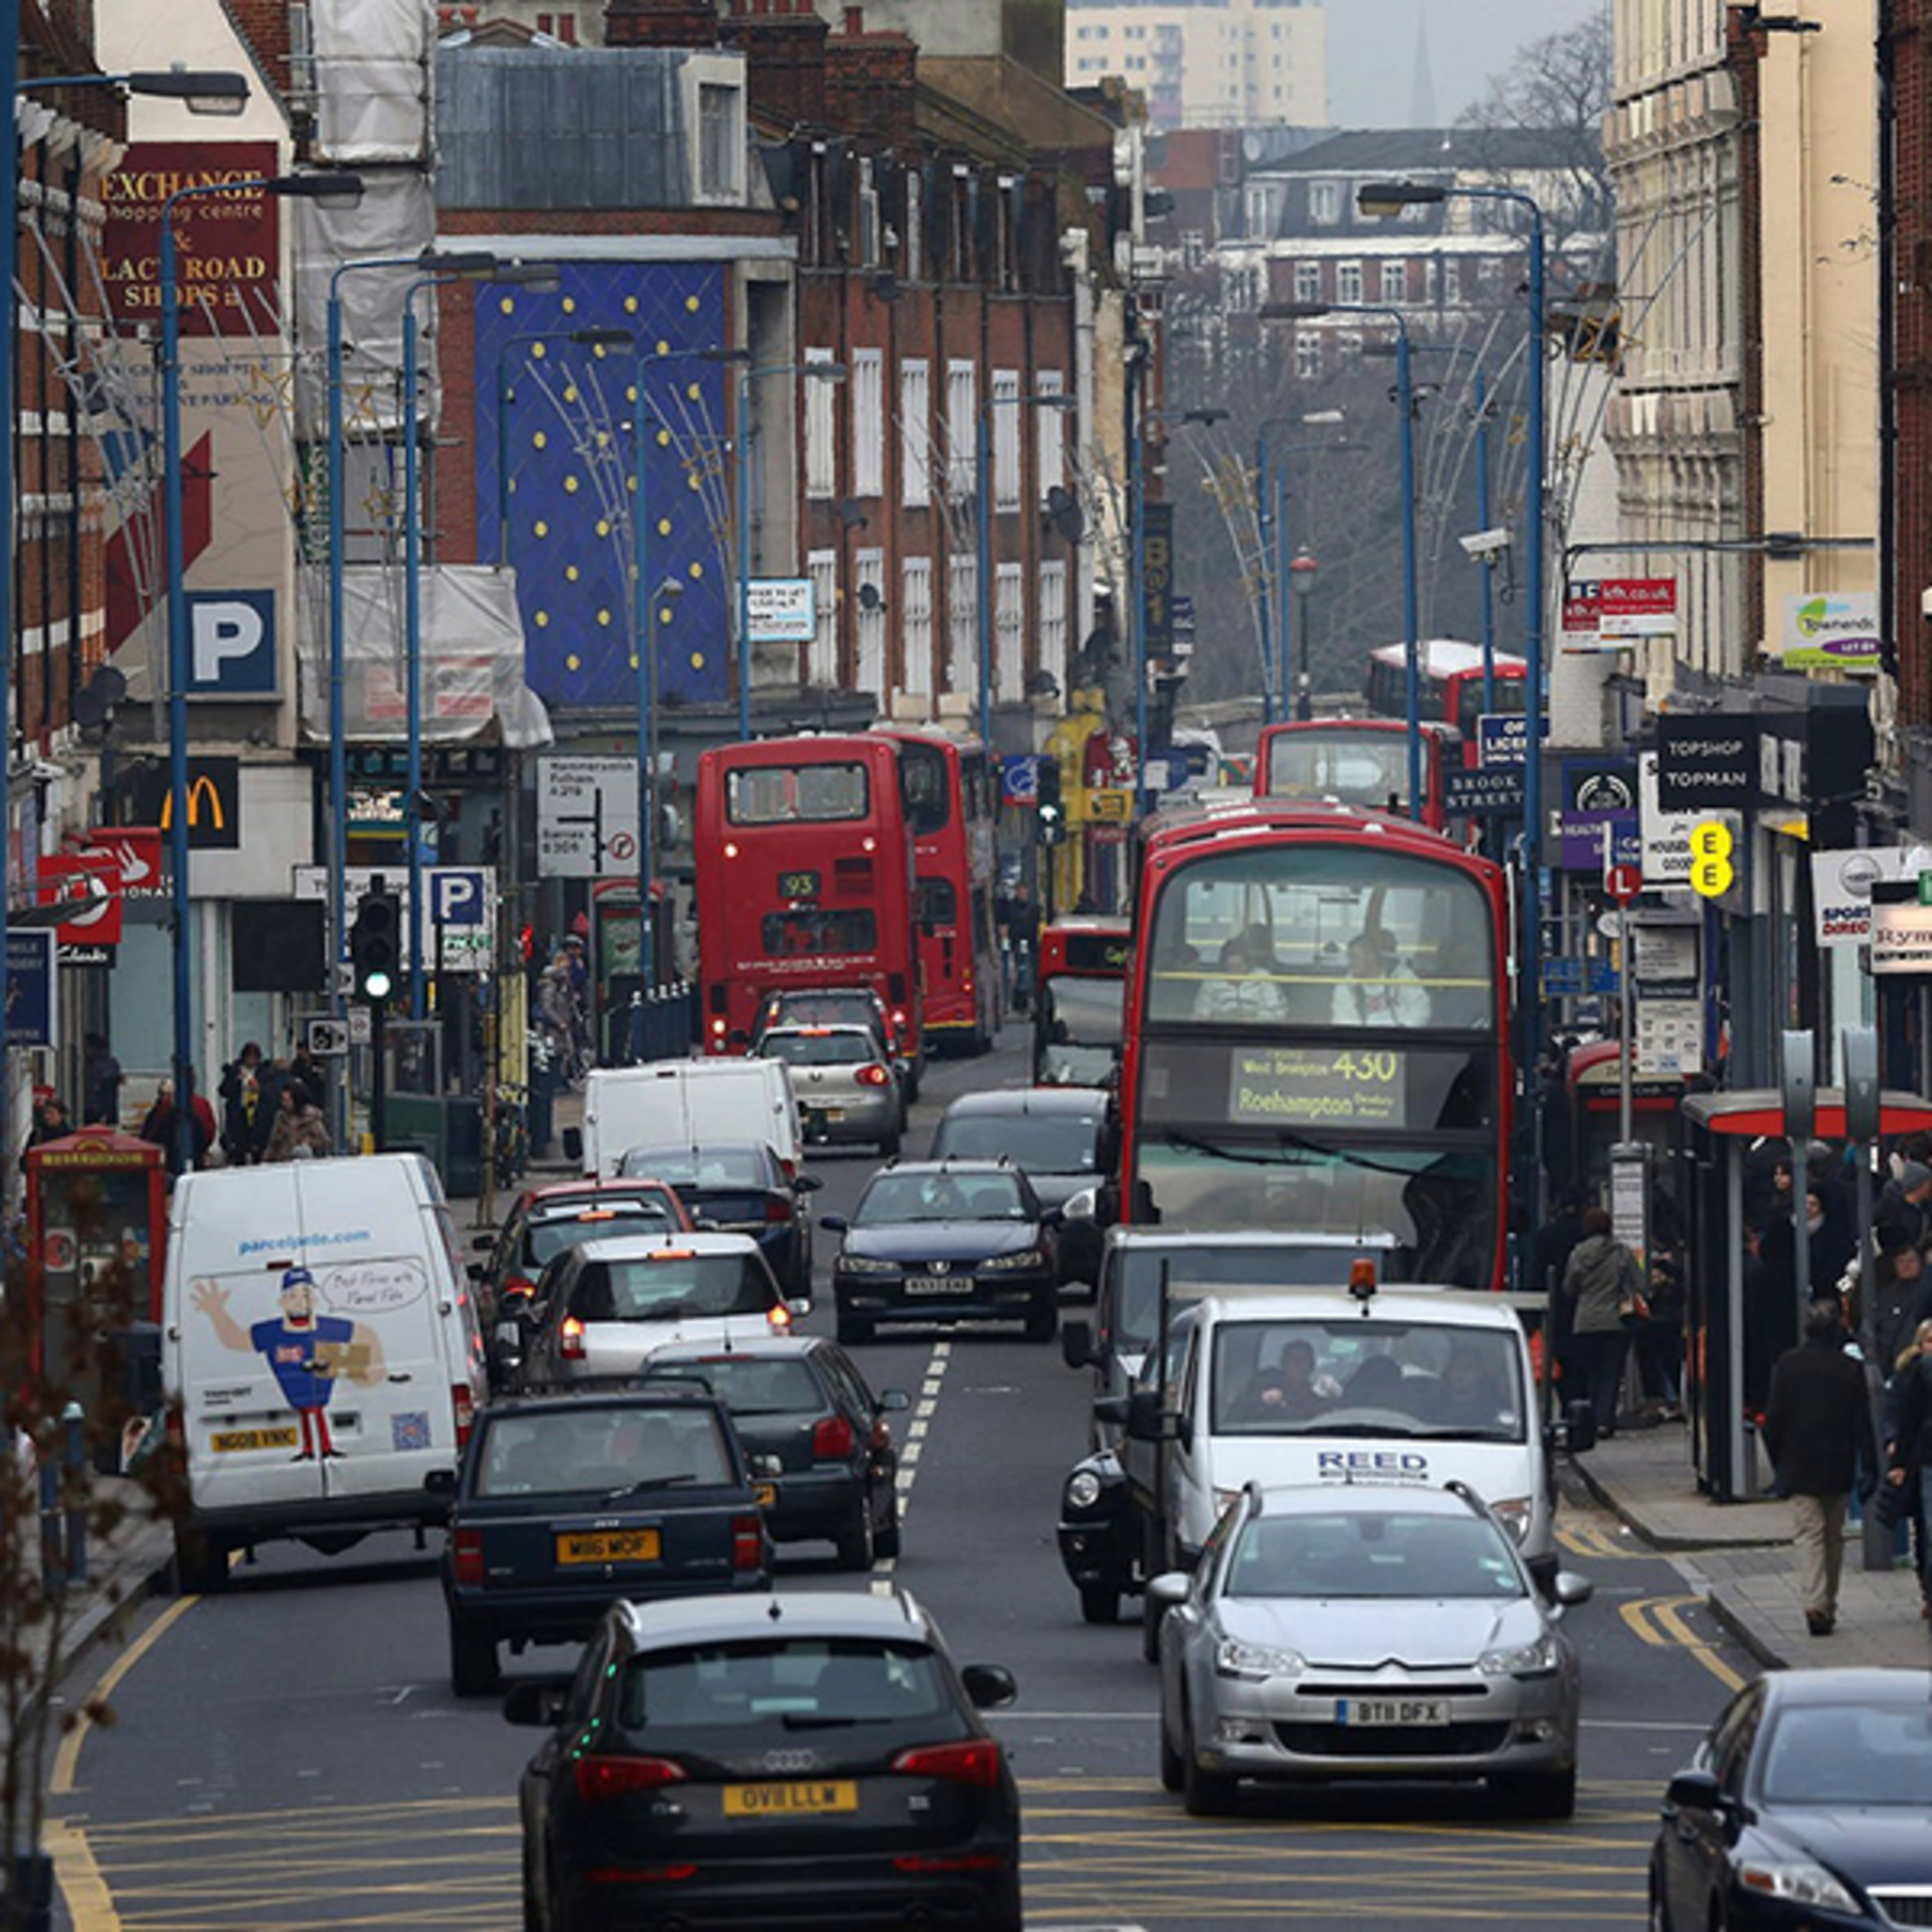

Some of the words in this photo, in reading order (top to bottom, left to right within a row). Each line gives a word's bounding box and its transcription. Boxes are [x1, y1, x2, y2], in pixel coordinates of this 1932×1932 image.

[101, 171, 264, 200] EXCHANGE
[199, 205, 263, 219] centre
[173, 229, 192, 251] &
[101, 257, 165, 281] LAC
[185, 258, 265, 279] ROAD
[1804, 617, 1875, 632] Townends
[193, 601, 263, 681] P
[1670, 741, 1743, 757] TOPSHOP
[550, 773, 596, 783] Fulham
[1452, 775, 1516, 791] BROOK
[1667, 771, 1747, 787] TOPMAN
[1446, 791, 1524, 808] STREET
[1703, 833, 1718, 854] E
[1616, 870, 1631, 893] L
[1704, 864, 1718, 886] E
[786, 876, 813, 896] 93
[440, 877, 474, 918] P
[1823, 921, 1871, 936] DIREC
[1332, 1051, 1397, 1082] 430
[1239, 1087, 1352, 1119] Roehampton
[1318, 1452, 1428, 1470] REED
[1358, 1703, 1395, 1721] BT11
[1400, 1703, 1439, 1721] DFX
